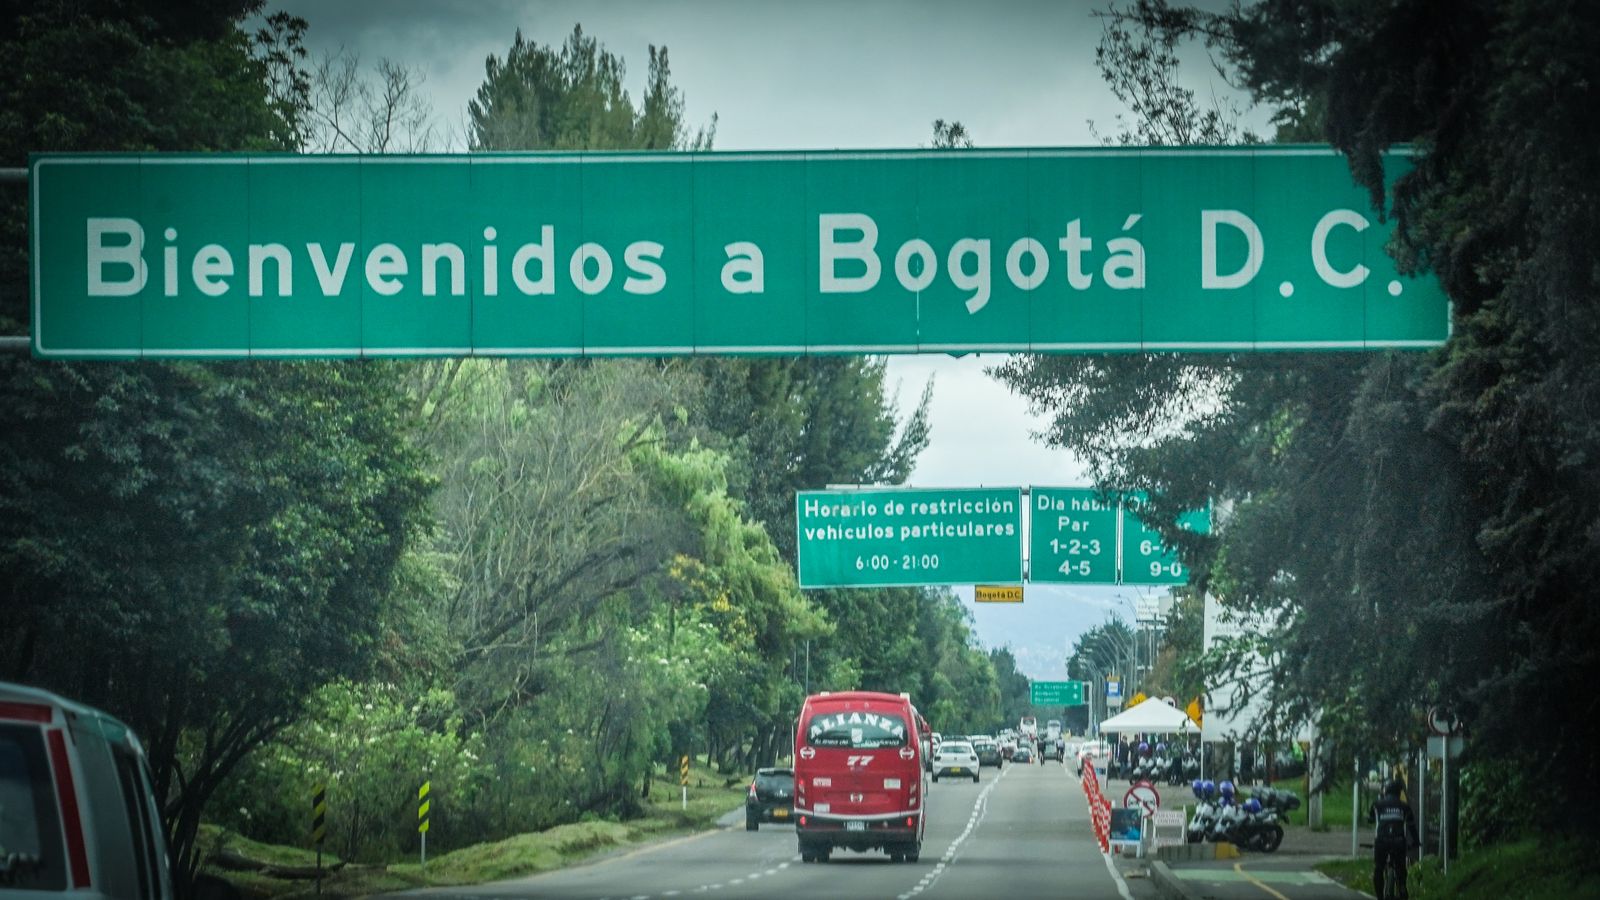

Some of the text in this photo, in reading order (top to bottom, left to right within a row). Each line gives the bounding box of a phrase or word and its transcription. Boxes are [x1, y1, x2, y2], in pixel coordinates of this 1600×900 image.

[86, 208, 1404, 314] Bienvenidos a Bogotá D.C.
[804, 497, 1013, 517] Horario de restricción
[901, 520, 1014, 541] particulares
[1058, 516, 1089, 532] Par
[1050, 538, 1101, 555] 1-2-3
[855, 554, 889, 570] 6:00
[902, 553, 939, 569] 21:00
[1058, 560, 1091, 576] 4-5
[1150, 561, 1182, 577] 9-0
[811, 712, 904, 740] ALIANZA
[847, 755, 874, 766] 77
